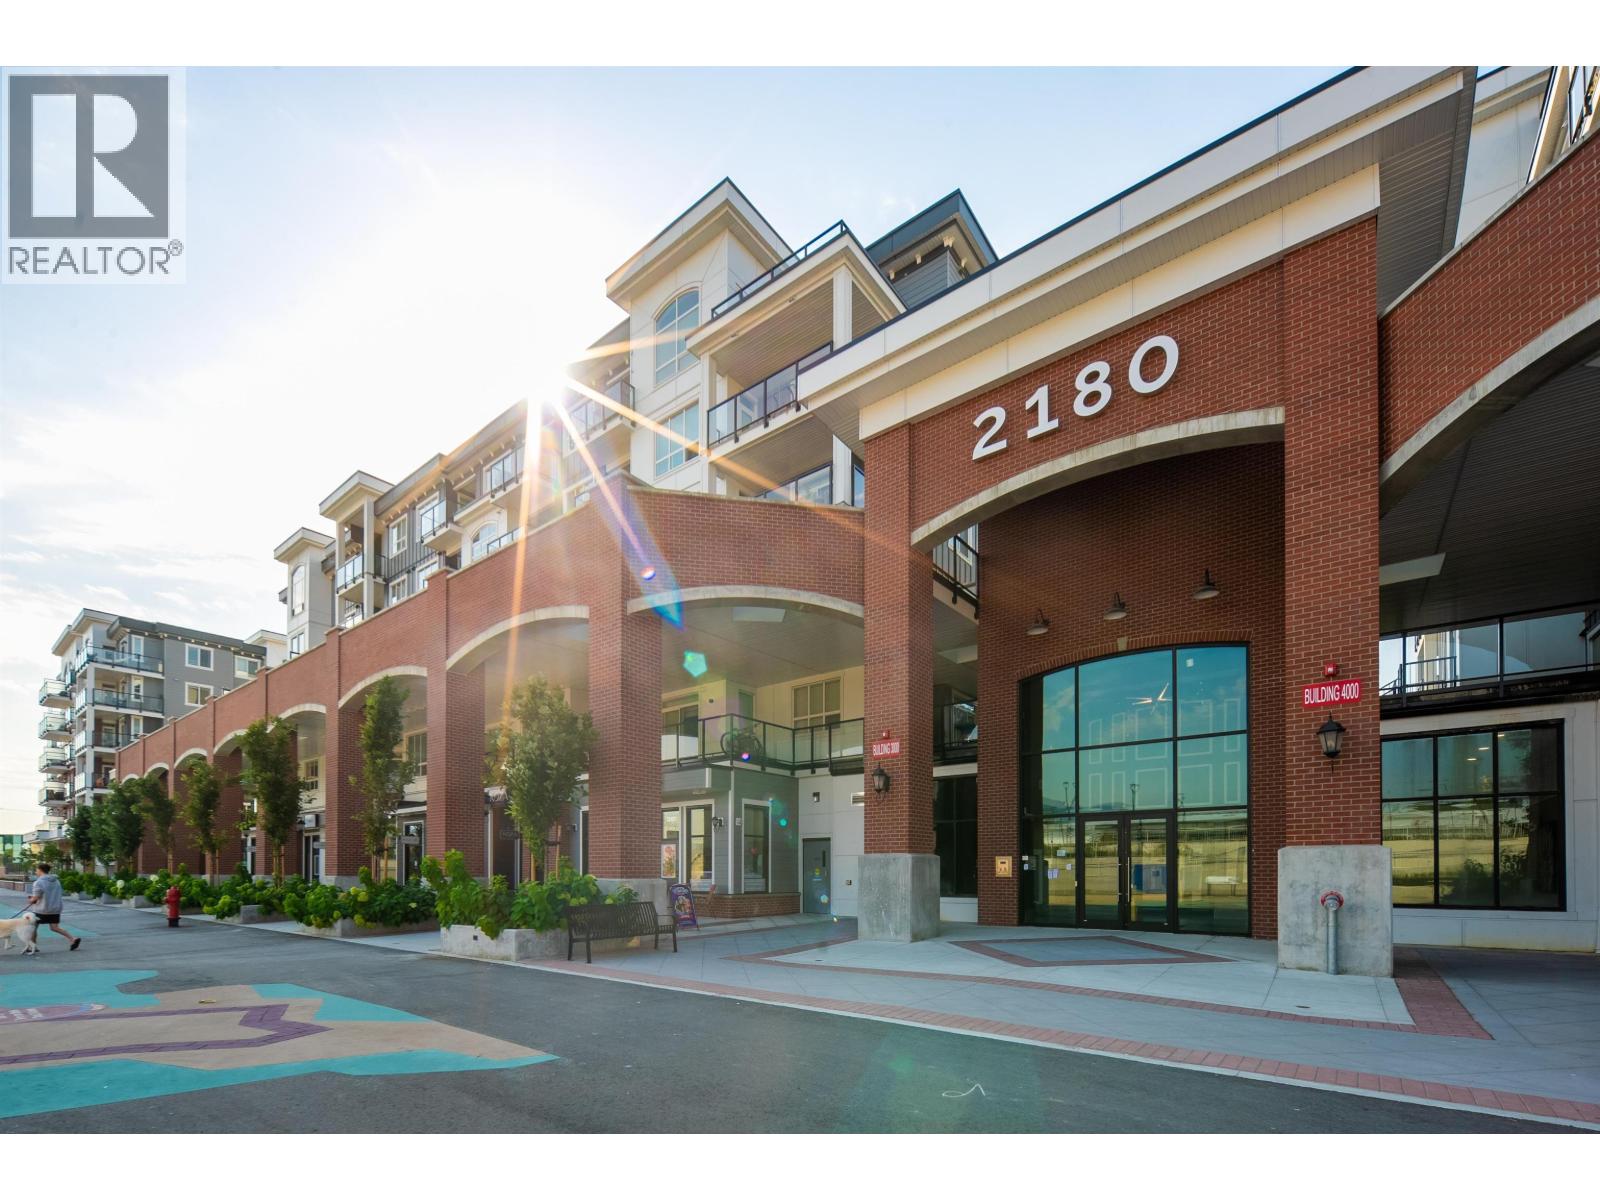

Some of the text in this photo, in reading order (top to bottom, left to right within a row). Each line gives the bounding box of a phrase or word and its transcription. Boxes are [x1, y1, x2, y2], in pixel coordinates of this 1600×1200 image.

[972, 335, 1179, 461] 2180
[1304, 682, 1360, 705] BUILDING 4000
